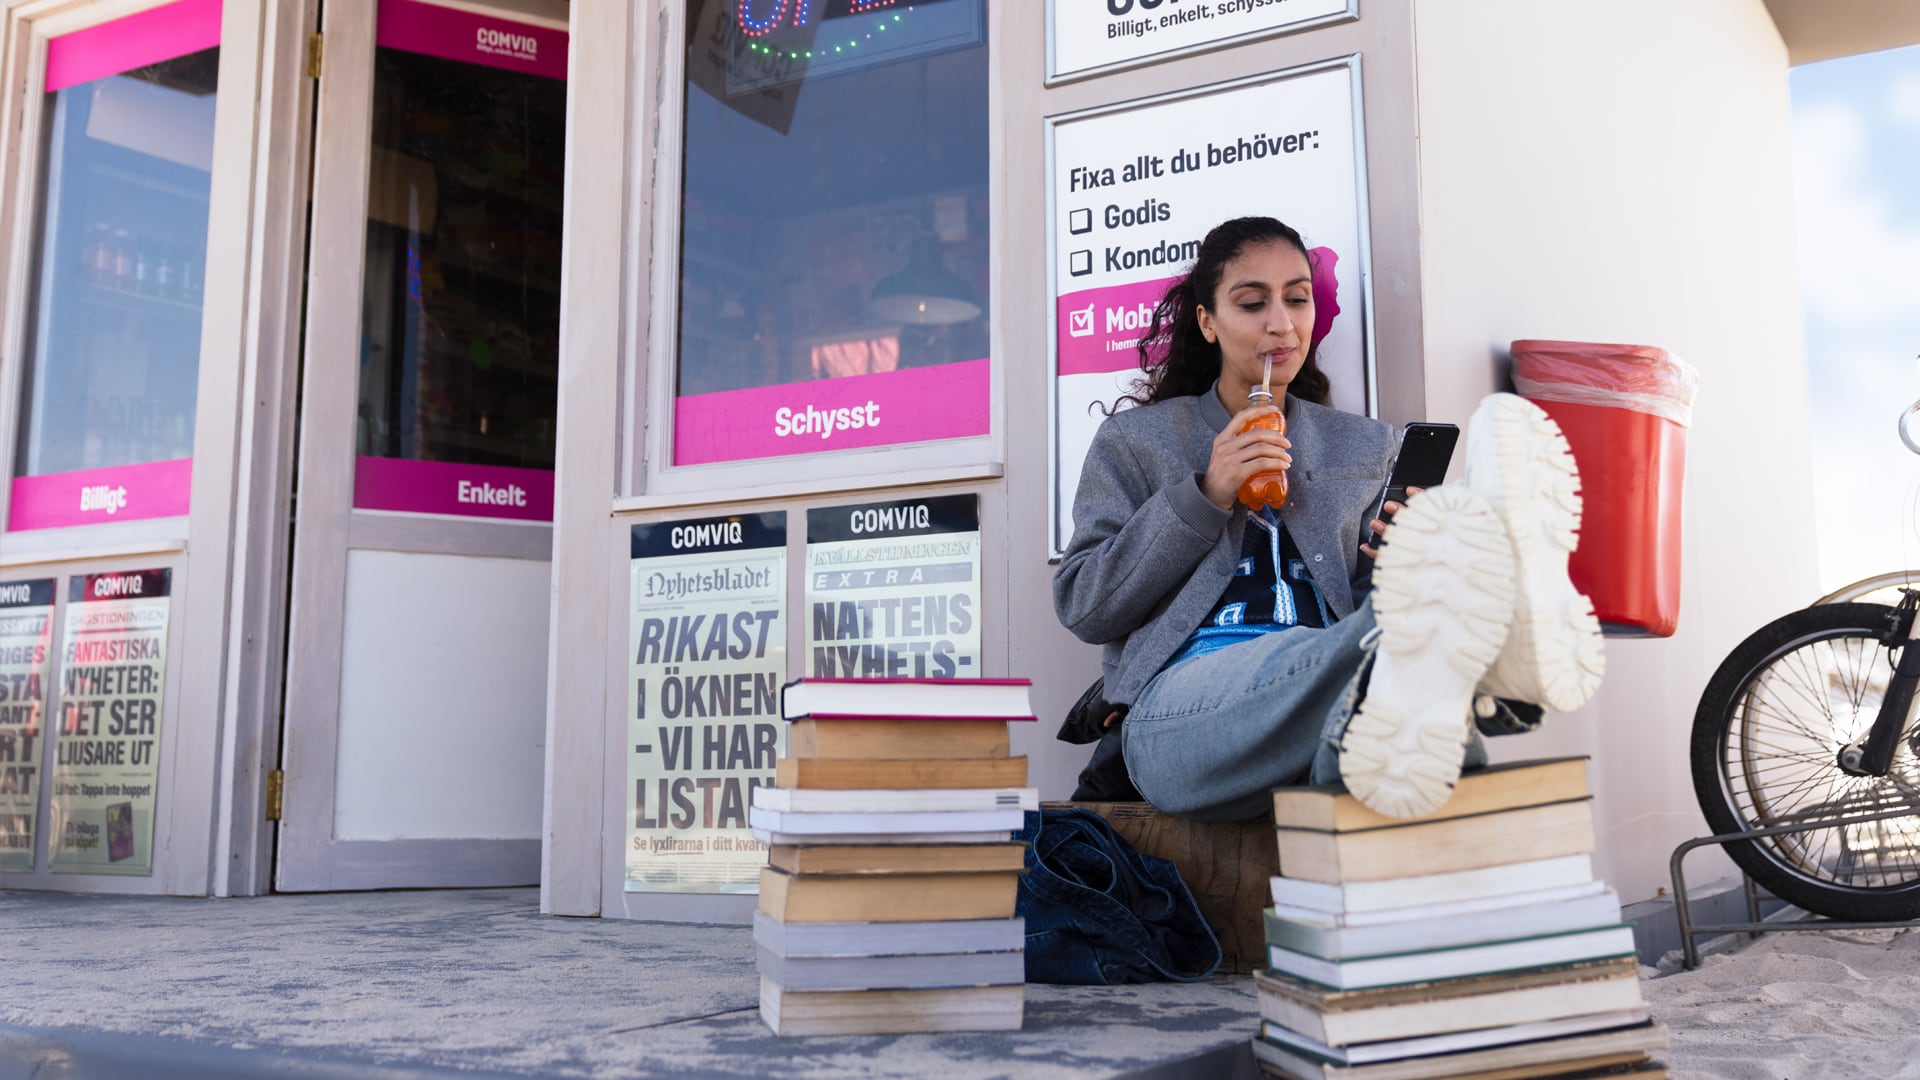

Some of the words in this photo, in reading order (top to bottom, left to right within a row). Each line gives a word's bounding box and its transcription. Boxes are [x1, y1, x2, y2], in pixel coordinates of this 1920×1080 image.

[1108, 18, 1157, 39] Billigt,
[1160, 5, 1214, 28] enkelt,
[477, 27, 537, 55] COMVIQ
[1070, 167, 1116, 192] Fixa
[1122, 155, 1164, 183] allt
[1171, 148, 1200, 174] du
[1207, 130, 1319, 167] behöver:
[1104, 198, 1171, 229] Godis
[774, 400, 881, 439] Schysst
[80, 485, 128, 514] Billigt
[458, 479, 527, 507] Enkelt
[850, 504, 931, 534] COMVIQ
[671, 521, 743, 549] COMVIQ
[0, 584, 31, 604] MVIQ
[94, 575, 143, 597] COMVIQ
[645, 565, 771, 600] Nyhetsbladet
[813, 593, 973, 641] NATTENS
[66, 638, 160, 664] FANTASTISKA
[636, 610, 779, 664] RIKAST
[813, 639, 972, 679] NYHETS-
[65, 665, 159, 696] NYHETER:
[637, 678, 646, 719] I
[661, 666, 777, 719] ÖKNEN
[60, 701, 105, 736] DET
[109, 699, 156, 735] SER
[58, 741, 125, 765] LJUSARE
[131, 740, 154, 765] UT
[658, 725, 693, 770] VI
[702, 724, 778, 770] HAR
[81, 783, 103, 799] Tappa
[105, 782, 120, 796] inte
[121, 782, 151, 799] hoppet
[633, 837, 647, 851] Se
[650, 836, 704, 853] lyxlirarna
[706, 837, 710, 850] i
[713, 837, 733, 851] ditt
